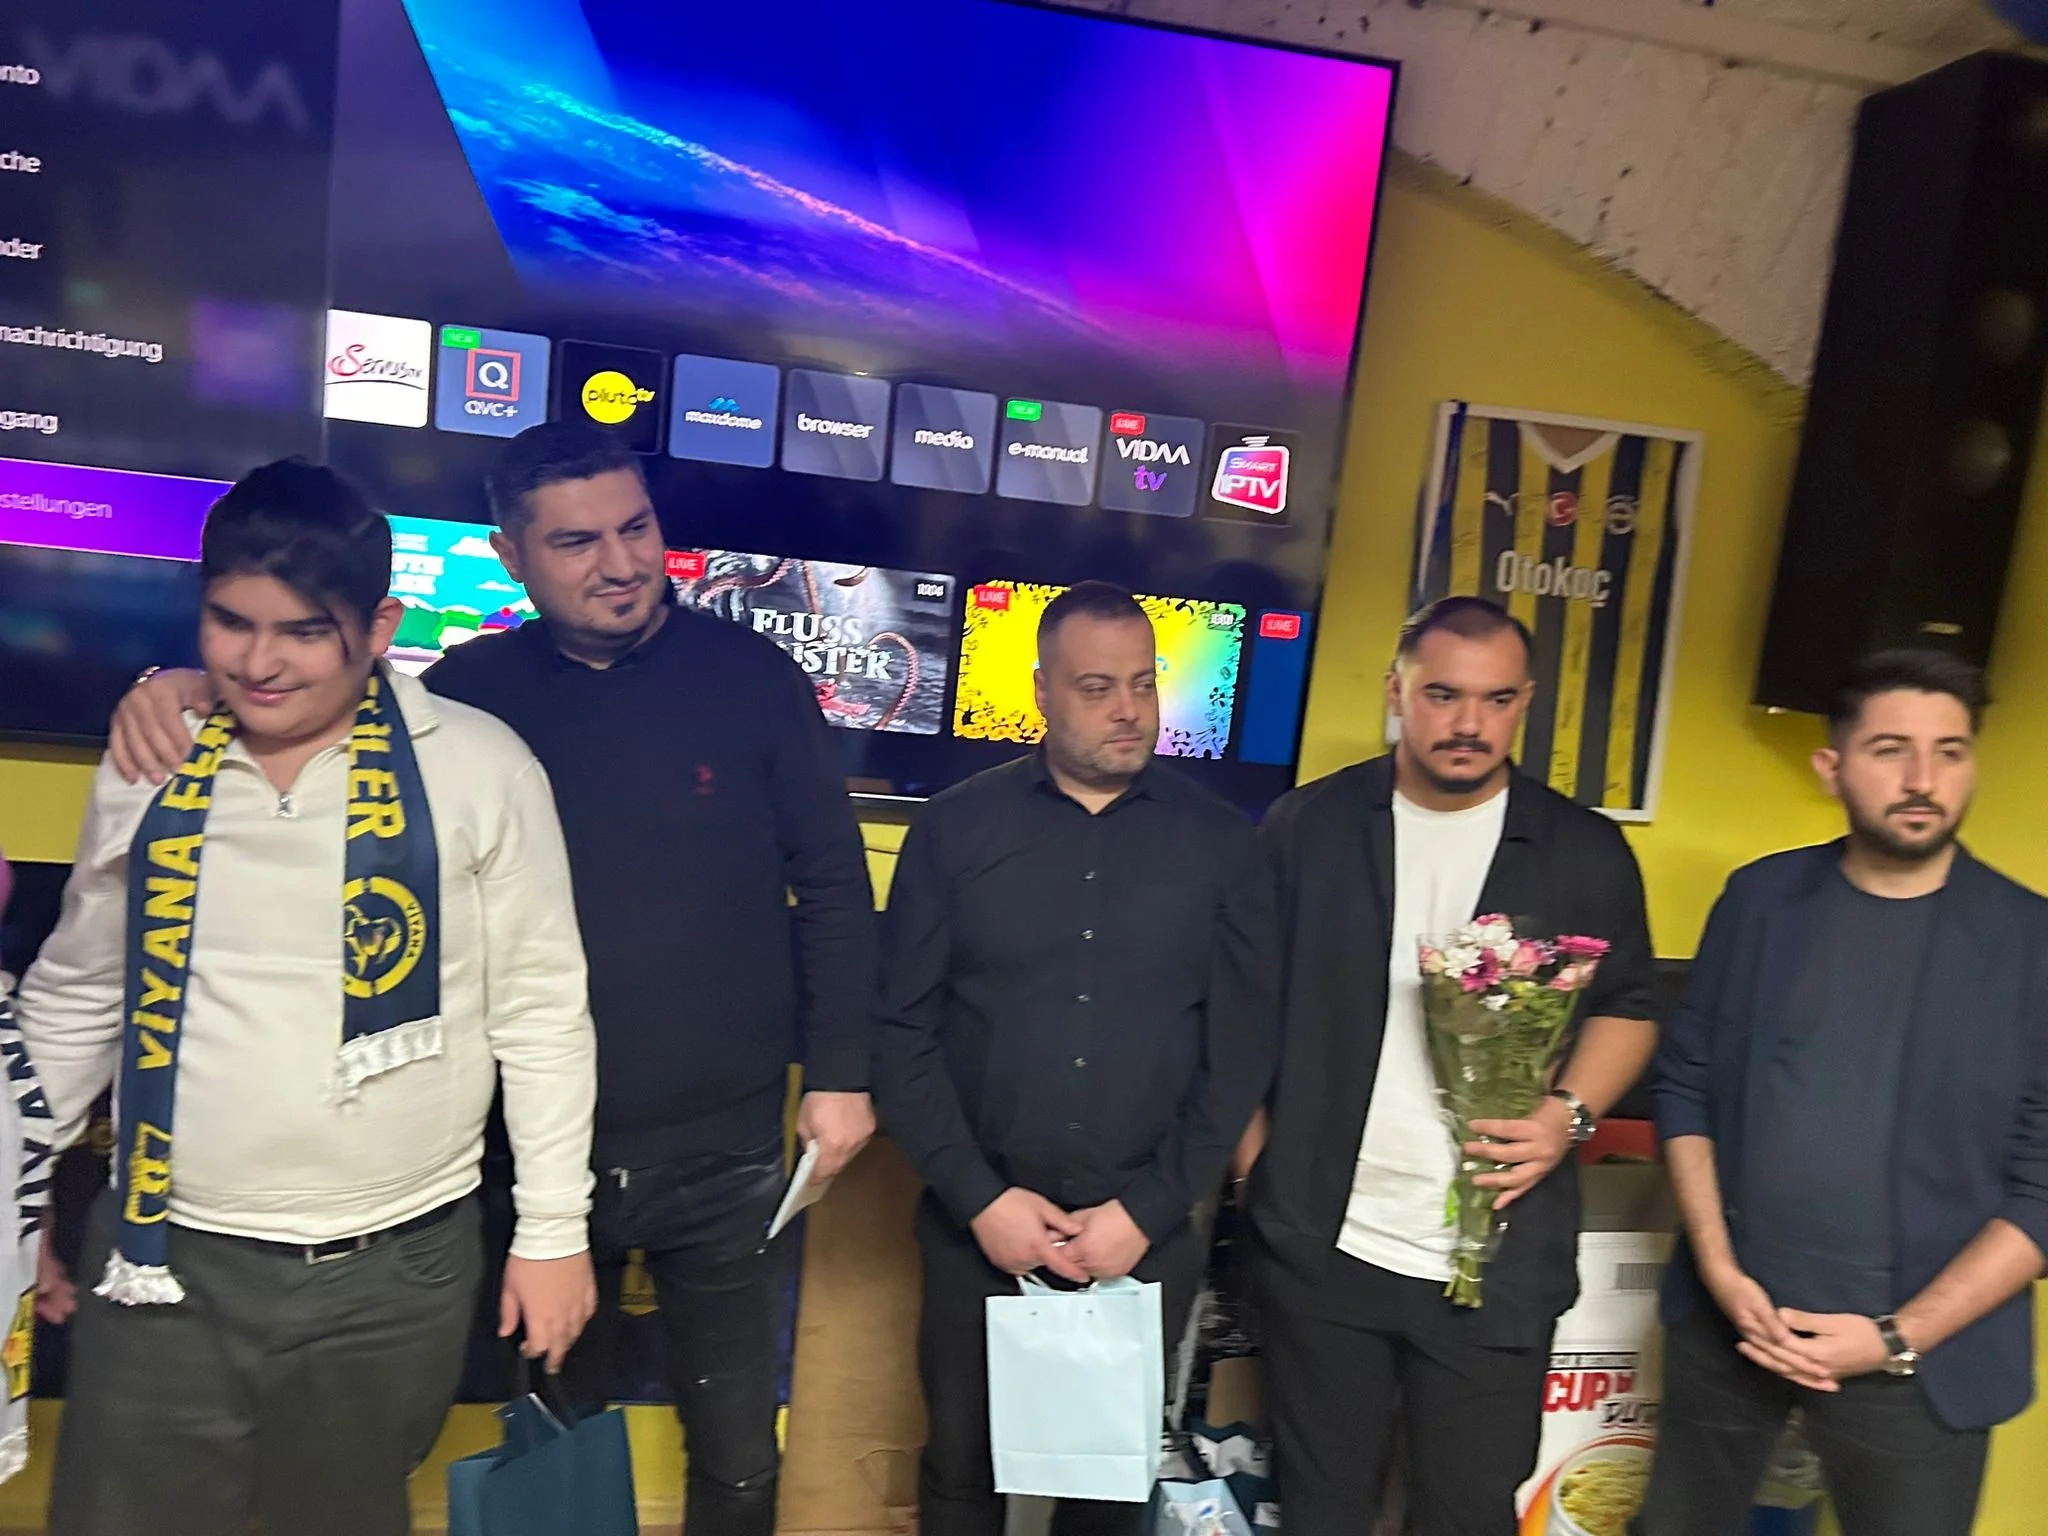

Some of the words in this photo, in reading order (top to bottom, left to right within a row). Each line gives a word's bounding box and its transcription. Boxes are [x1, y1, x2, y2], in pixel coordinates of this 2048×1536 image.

[478, 361, 509, 390] Q
[464, 400, 518, 418] QVC+
[797, 413, 874, 439] browser
[914, 428, 974, 450] media
[1008, 441, 1089, 464] e-manual
[1134, 464, 1168, 491] tv
[1219, 474, 1281, 499] IPTV
[750, 608, 863, 645] FLUSS
